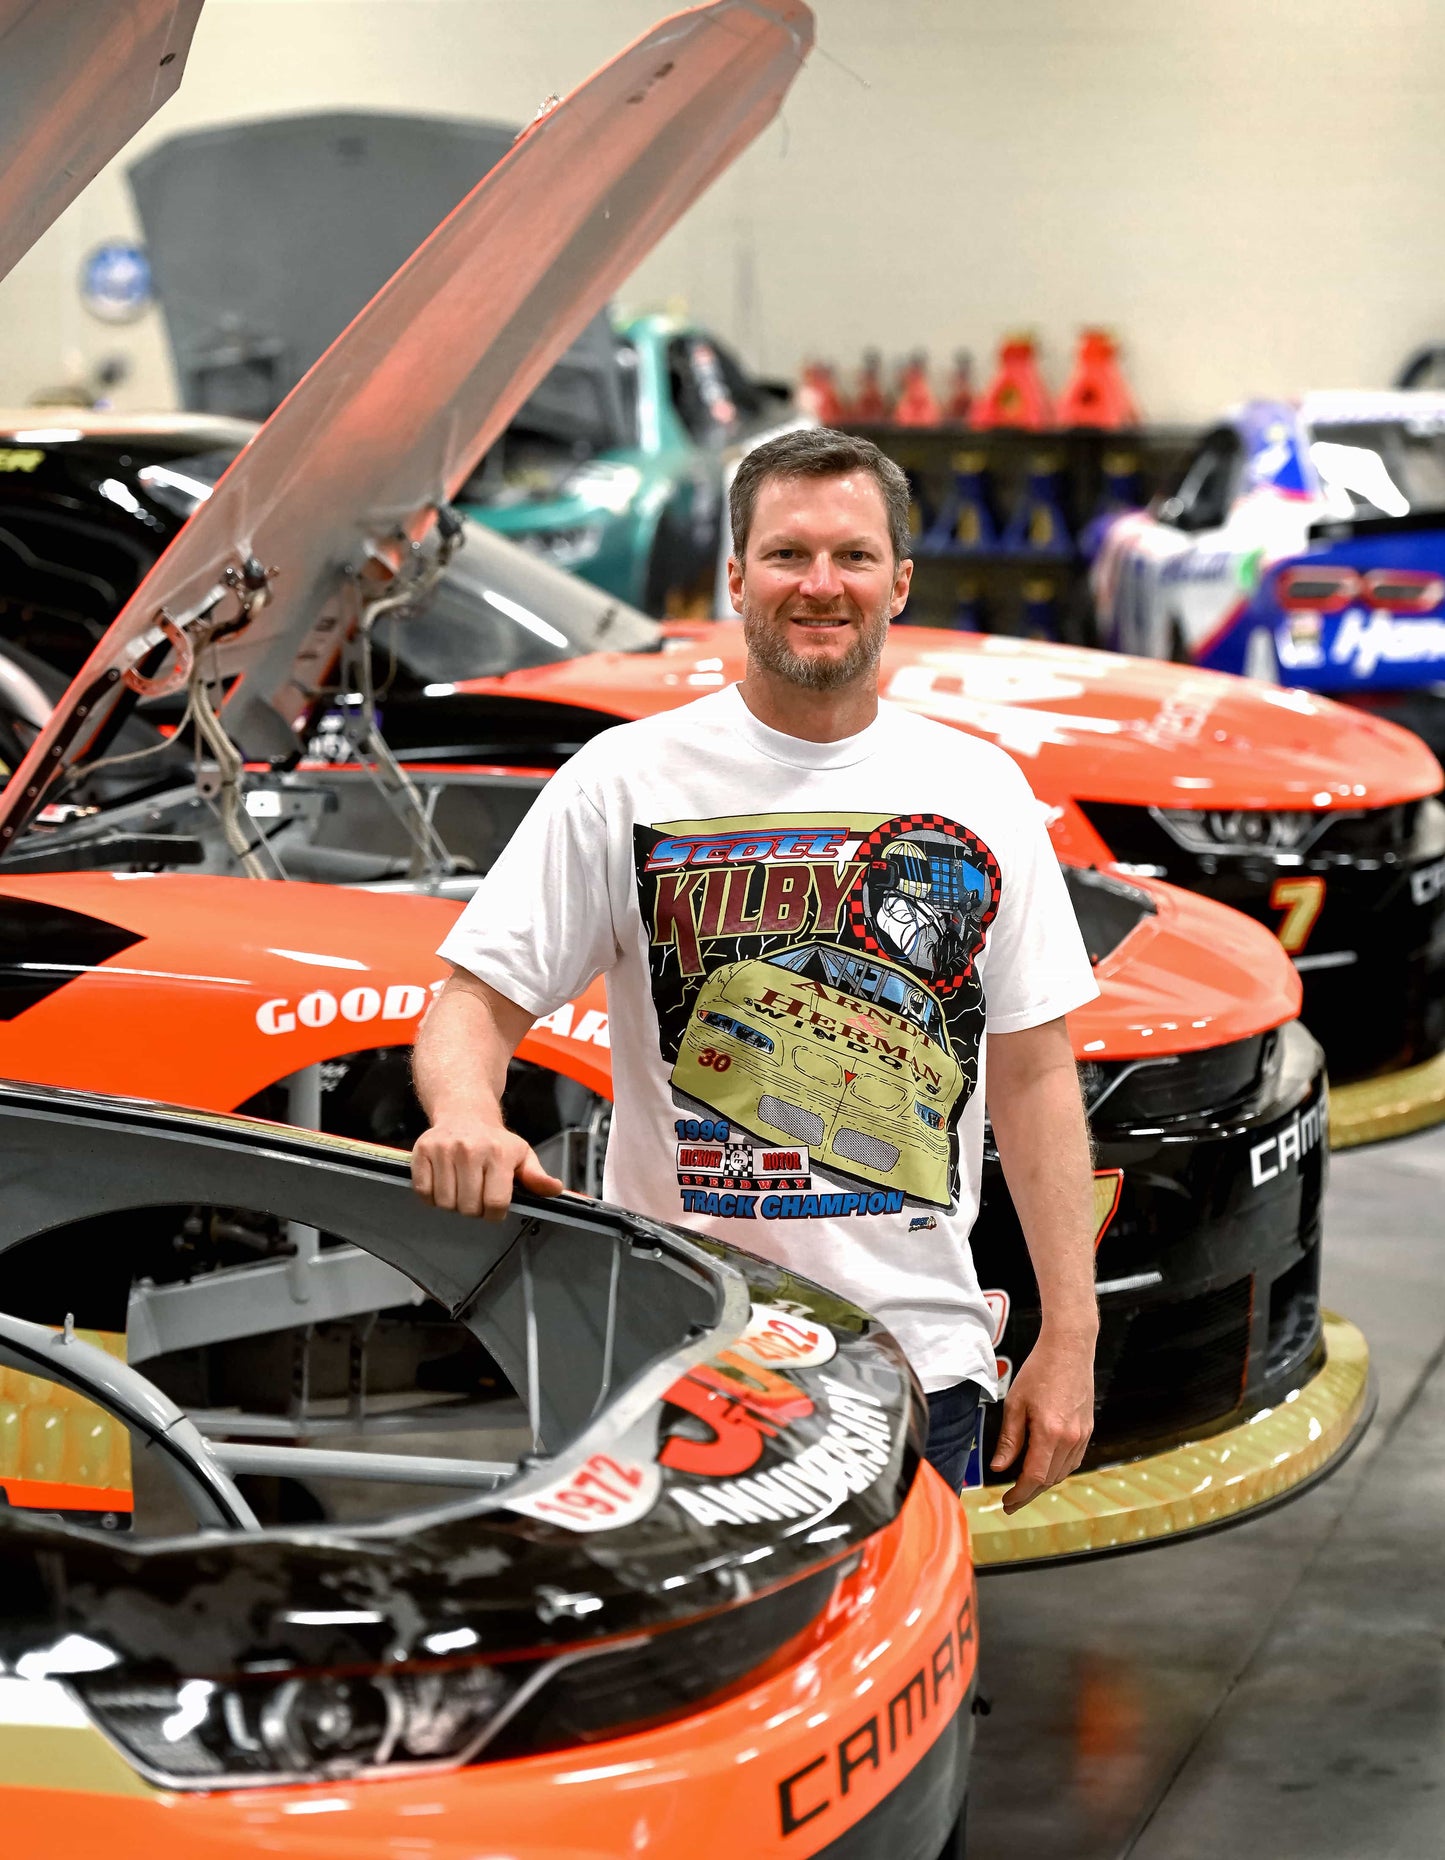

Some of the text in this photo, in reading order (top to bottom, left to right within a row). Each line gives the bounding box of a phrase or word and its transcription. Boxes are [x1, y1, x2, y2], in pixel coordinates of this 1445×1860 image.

[650, 862, 870, 978] KILBY
[1269, 876, 1327, 954] 7
[255, 982, 612, 1048] GOODAR
[791, 980, 936, 1050] ARNDT
[698, 1046, 732, 1073] 30
[674, 1119, 730, 1142] 1996
[680, 1149, 723, 1168] HICKORY
[762, 1152, 801, 1170] MOTOR
[682, 1175, 806, 1190] SPEEDWAY
[680, 1189, 906, 1220] TRACK CHAMPION
[734, 1320, 818, 1360] 2022
[669, 1375, 892, 1527] ANNIVERSARY
[535, 1455, 644, 1521] 1972
